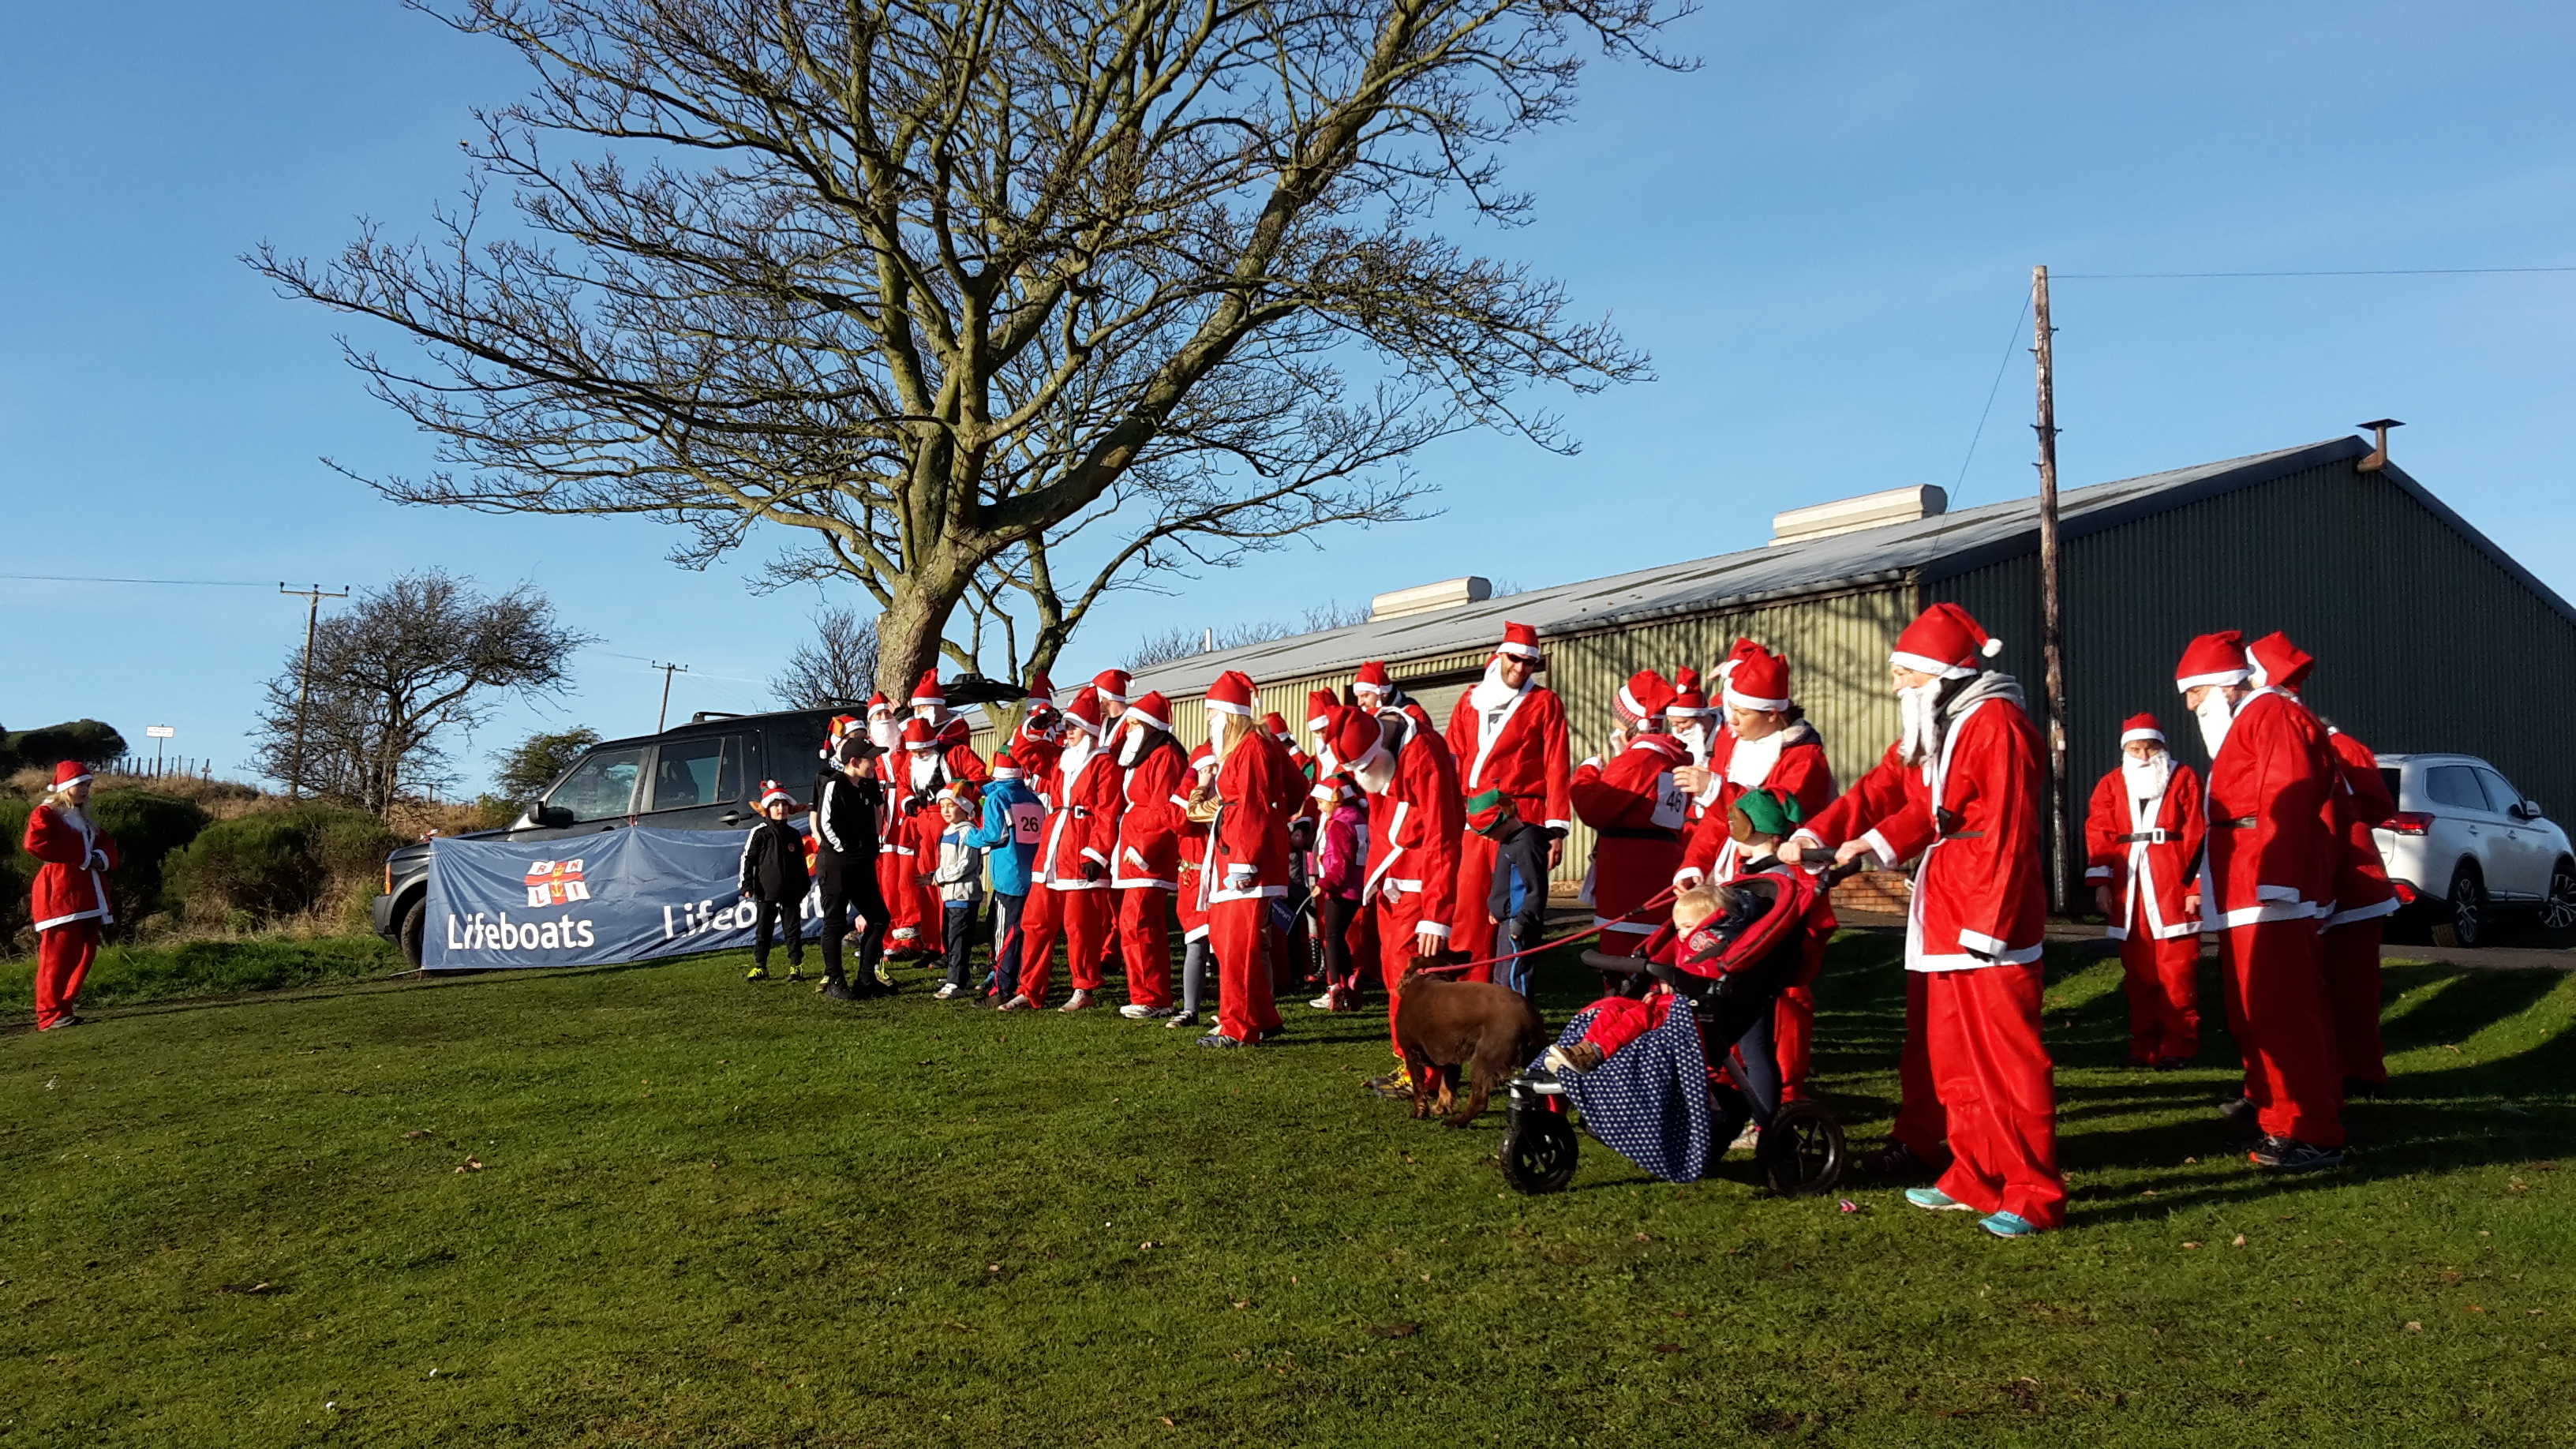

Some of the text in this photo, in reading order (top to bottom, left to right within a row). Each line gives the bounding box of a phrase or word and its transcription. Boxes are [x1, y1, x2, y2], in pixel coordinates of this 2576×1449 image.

[1665, 791, 1683, 813] 46
[1020, 816, 1039, 833] 26
[447, 912, 595, 950] Lifeboats
